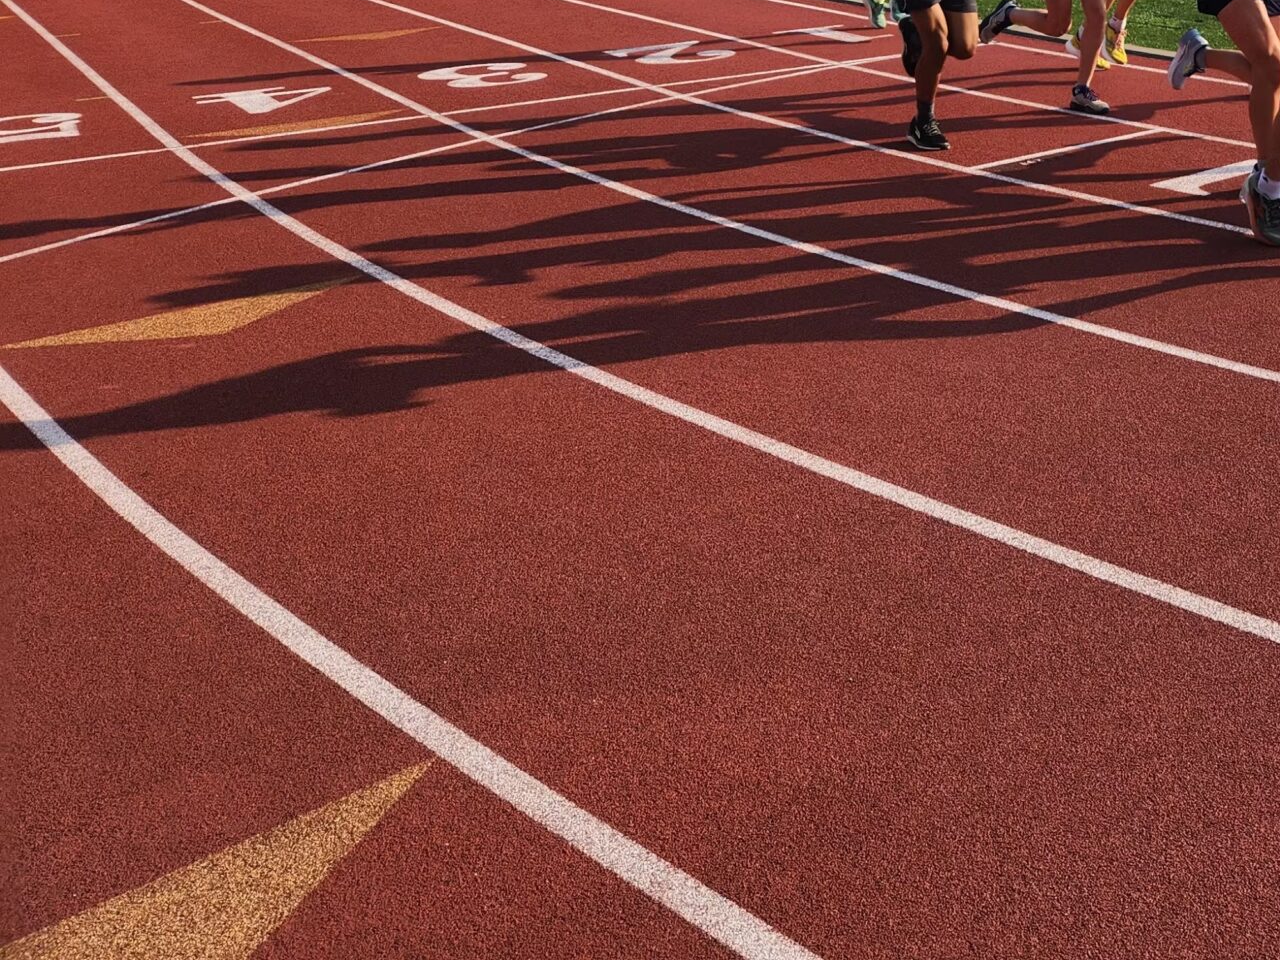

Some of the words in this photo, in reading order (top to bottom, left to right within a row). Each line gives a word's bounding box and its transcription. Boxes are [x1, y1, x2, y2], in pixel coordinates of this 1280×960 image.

[603, 40, 737, 65] 2
[416, 62, 549, 88] 3
[191, 85, 332, 114] 4
